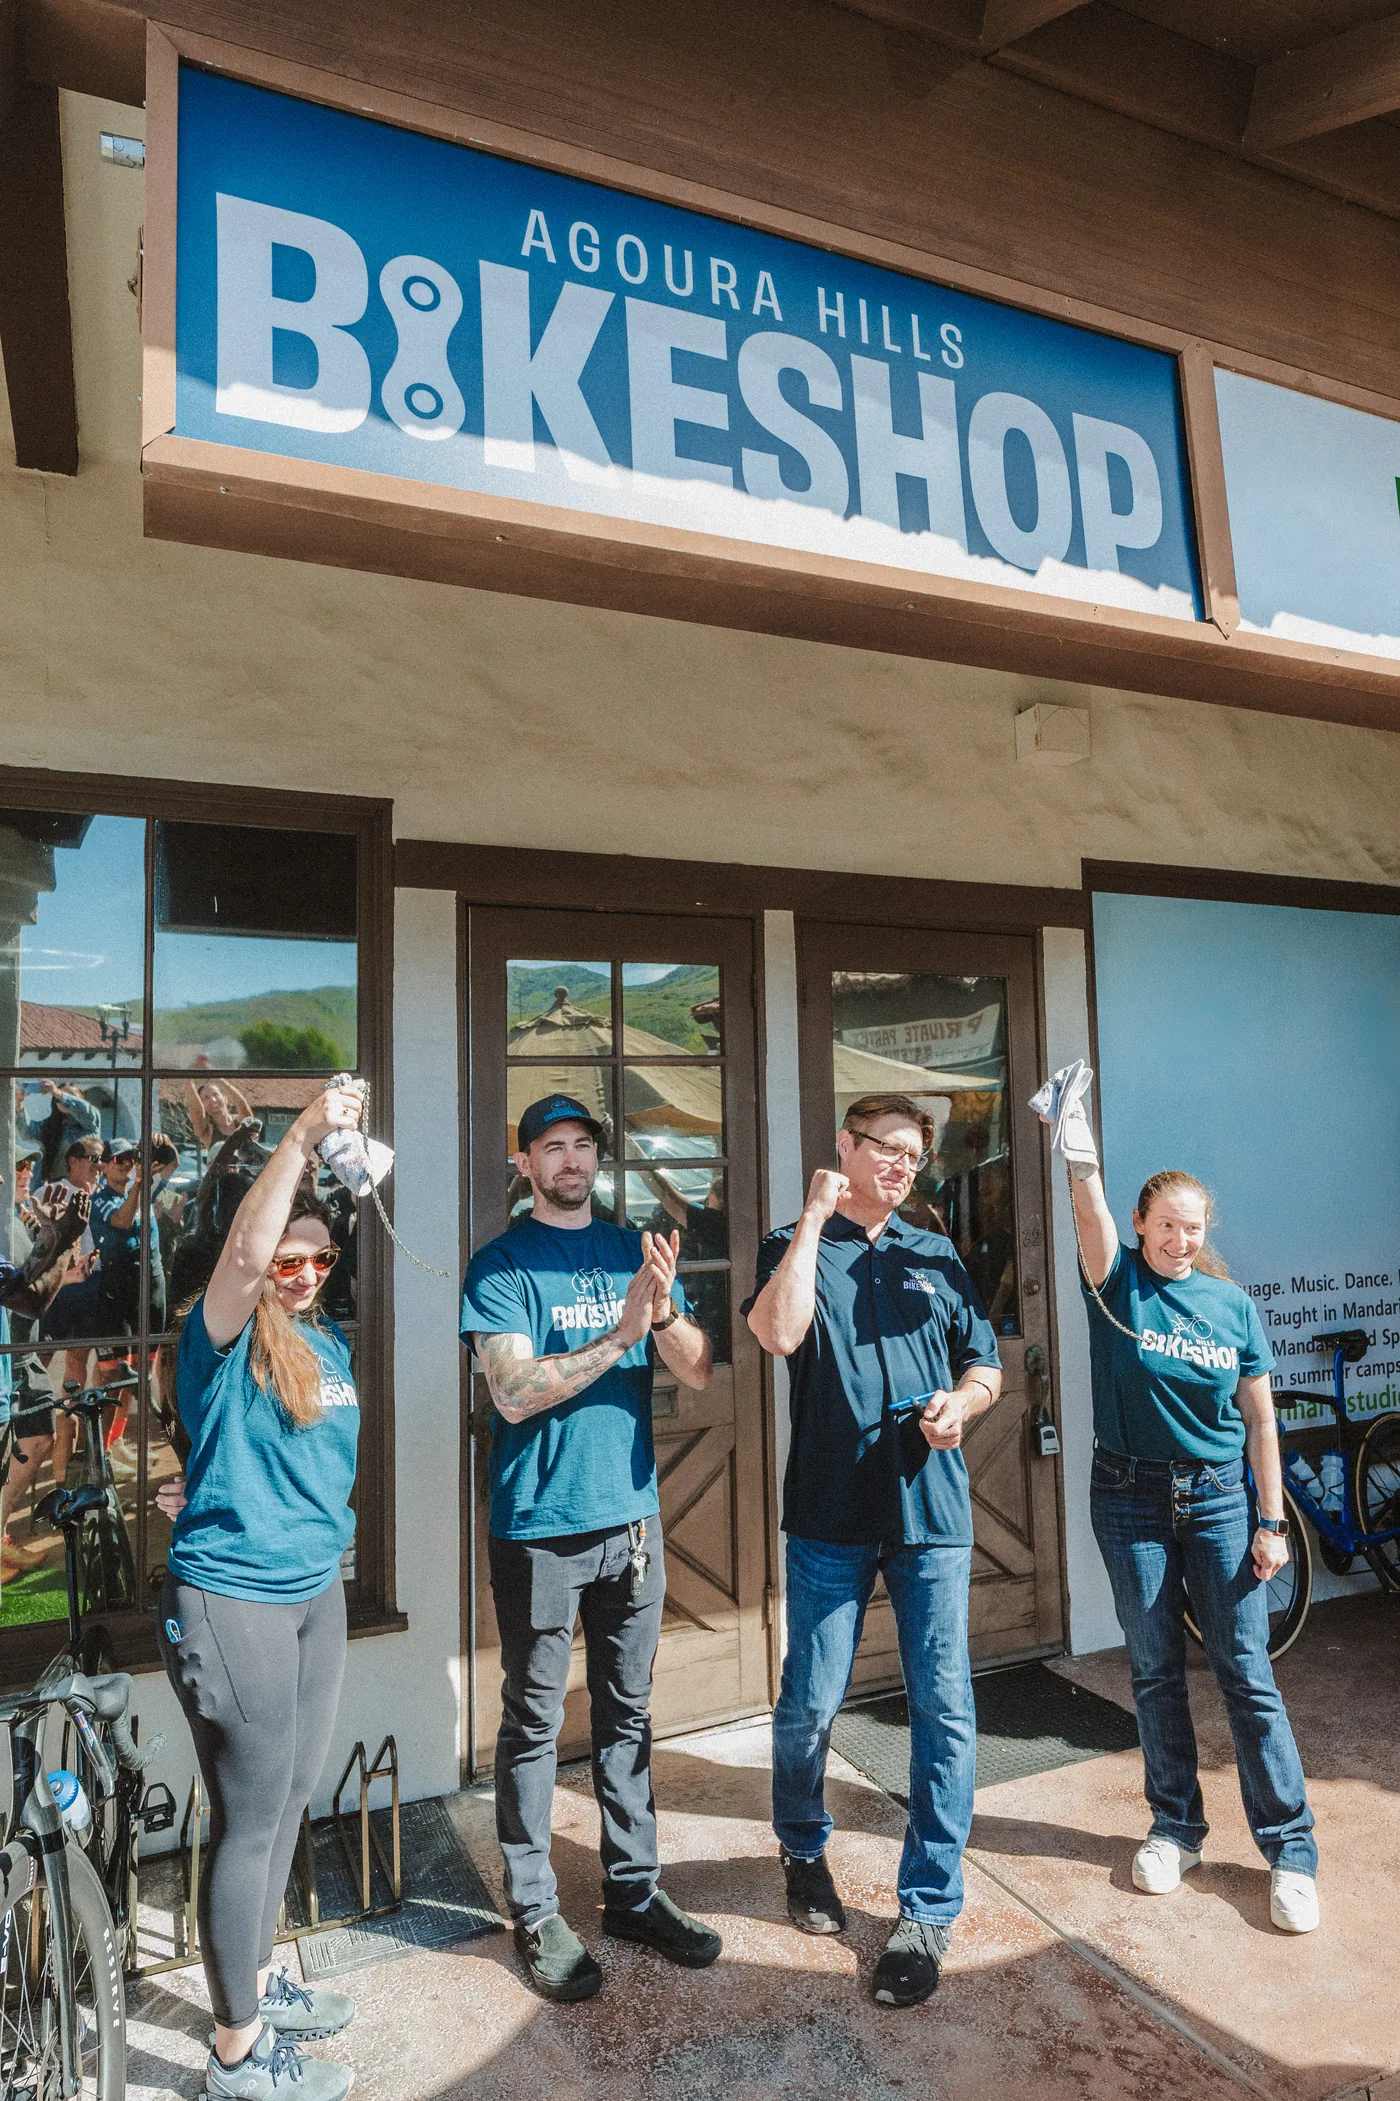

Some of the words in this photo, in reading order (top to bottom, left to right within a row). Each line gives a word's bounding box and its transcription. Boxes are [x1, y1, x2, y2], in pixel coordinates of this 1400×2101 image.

[520, 208, 783, 322] AGOURA
[817, 286, 965, 369] HILLS
[215, 191, 1163, 575] BIKESHOP
[1241, 1281, 1286, 1301] uage.
[1291, 1274, 1339, 1294] Music.
[1345, 1272, 1393, 1289] Dance.
[551, 1298, 626, 1332] BIKESHO
[1265, 1306, 1318, 1329] Taught
[1323, 1305, 1337, 1322] in
[1343, 1298, 1400, 1320] Mandari
[1289, 1365, 1351, 1386] summr
[1346, 1383, 1400, 1413] studi
[103, 1927, 120, 2028] RESERVE
